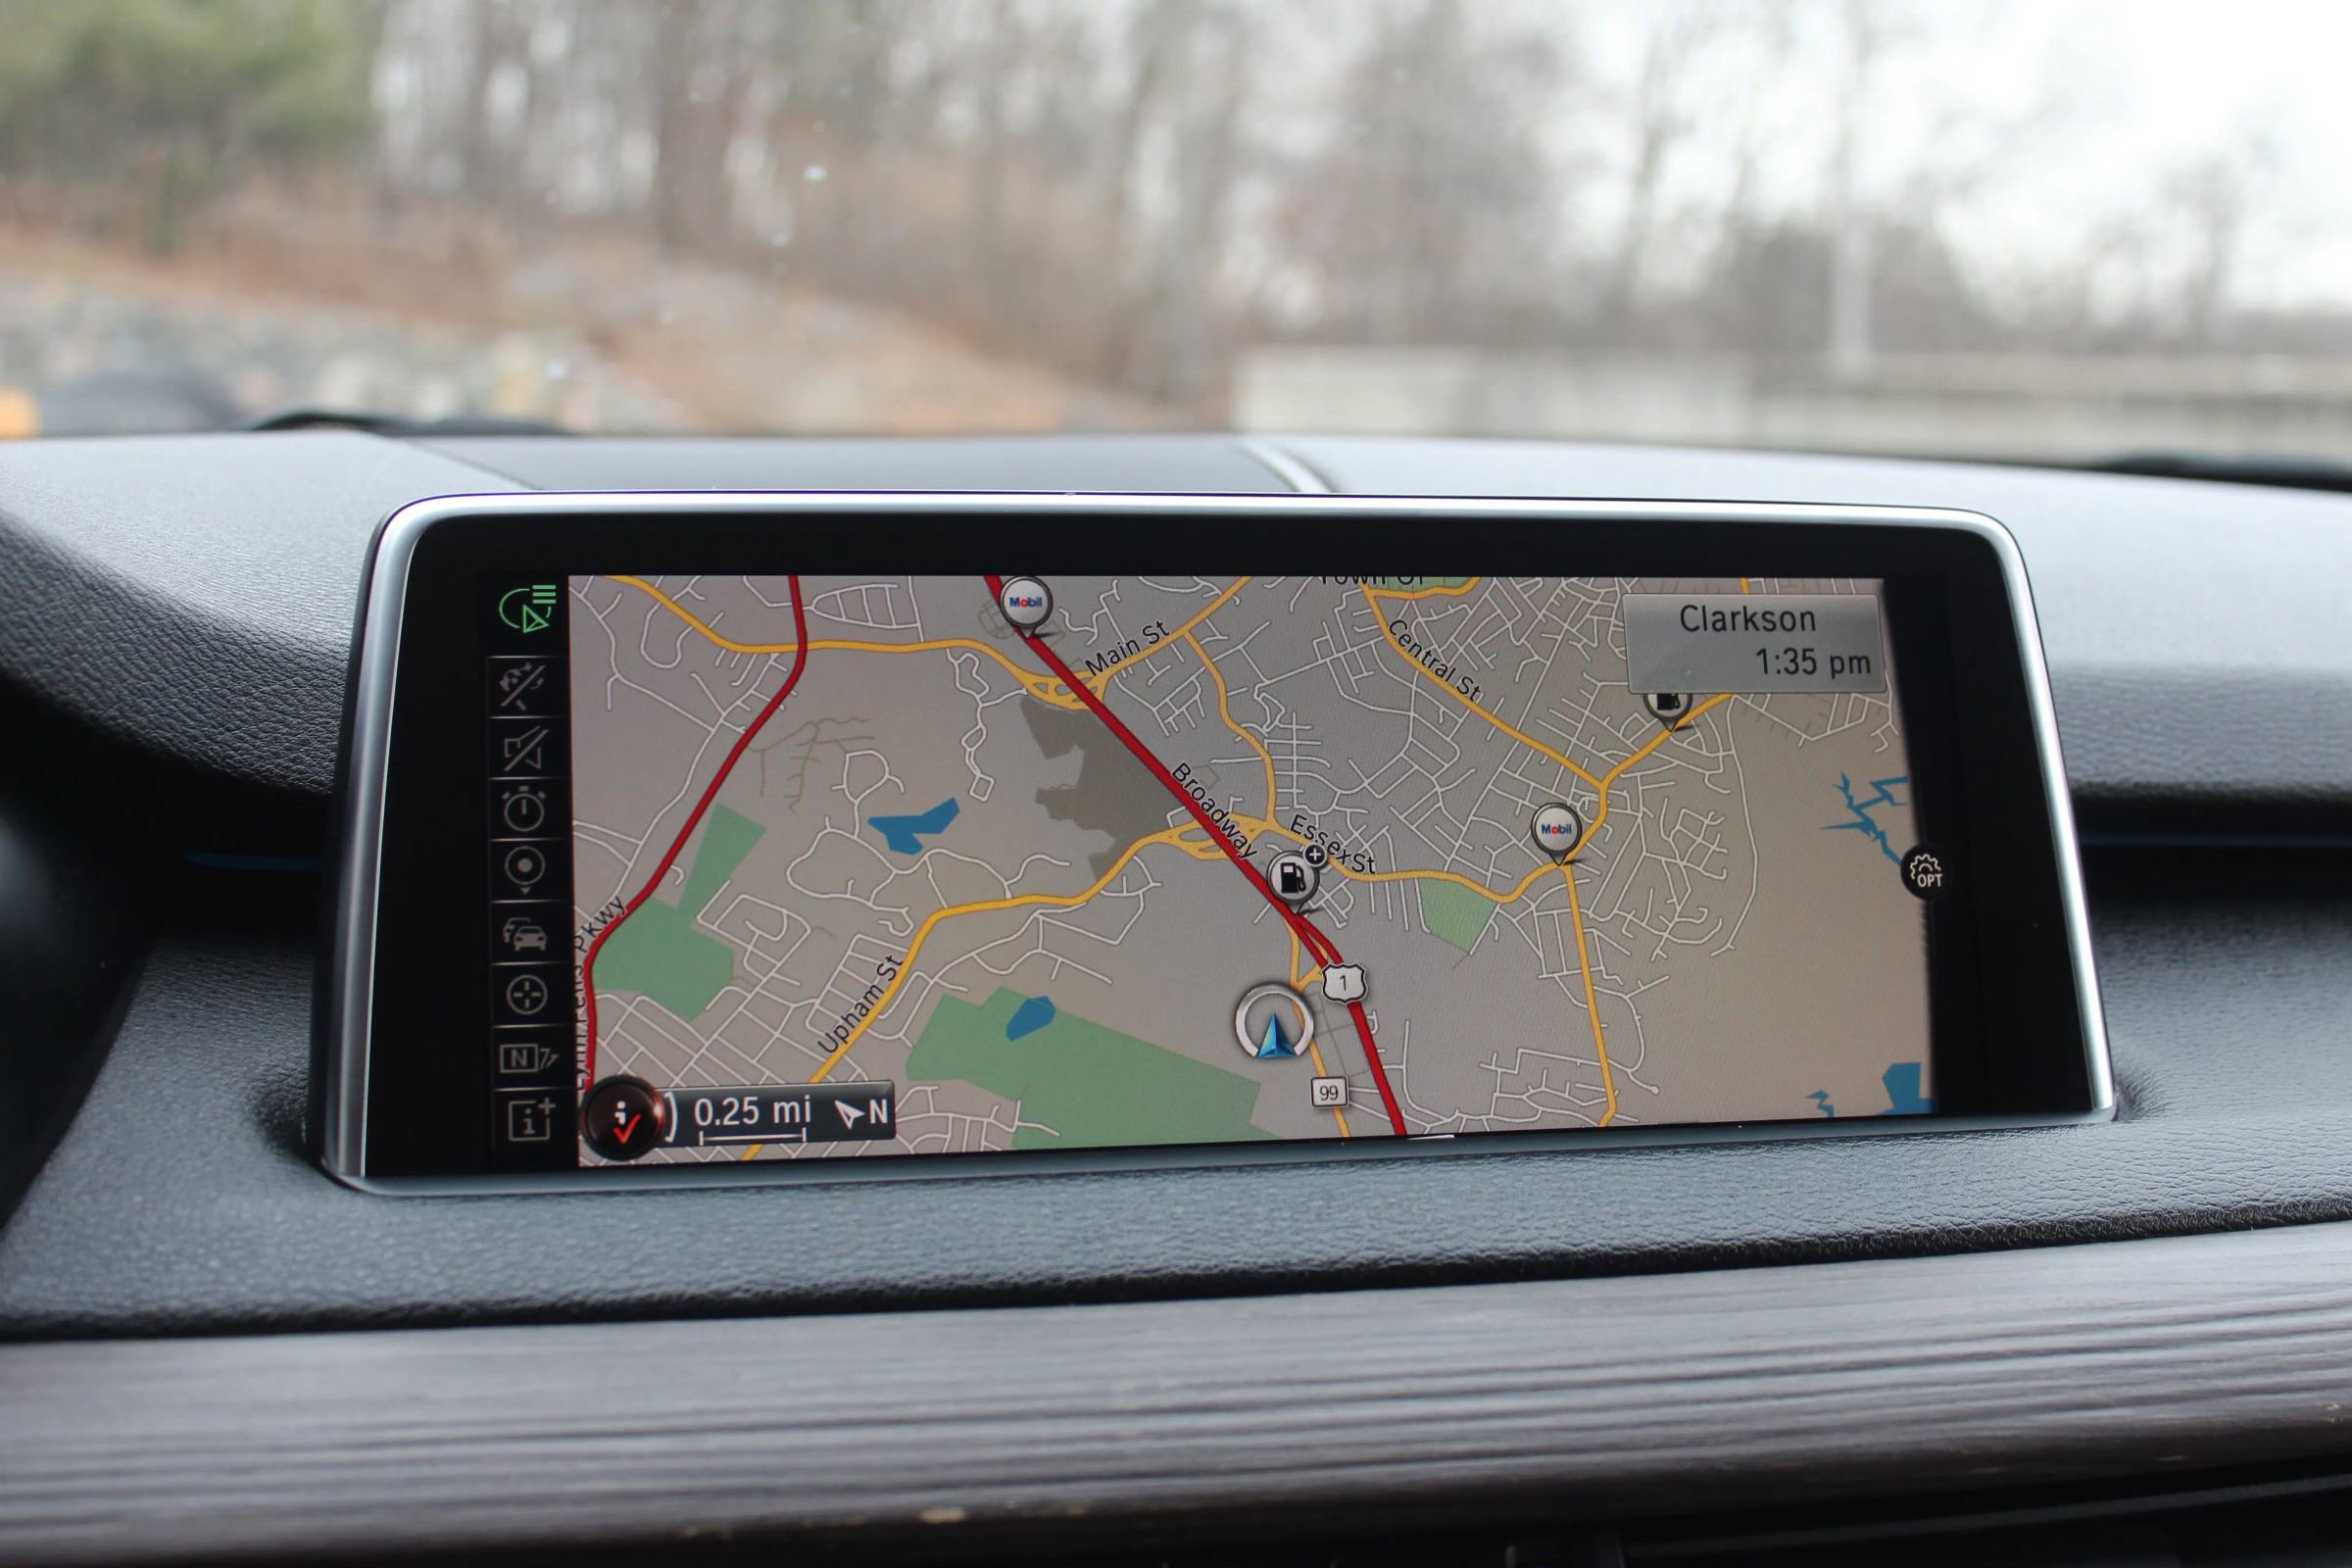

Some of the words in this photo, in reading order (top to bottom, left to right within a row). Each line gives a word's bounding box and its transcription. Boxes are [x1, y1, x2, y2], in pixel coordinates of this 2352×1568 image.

[1008, 596, 1043, 608] Mobil
[1680, 604, 1816, 632] Clarkson
[1084, 636, 1141, 676] Main
[1142, 619, 1170, 645] St
[1389, 619, 1457, 683] Central
[1456, 675, 1482, 703] St
[1755, 647, 1818, 675] 1:35
[1829, 654, 1872, 680] pm
[1171, 761, 1257, 859] Broadway
[1290, 814, 1352, 864] Essex
[1351, 854, 1376, 875] St
[1541, 822, 1572, 836] Mobil
[1917, 872, 1943, 888] OPT
[573, 895, 626, 954] Pkwy
[1339, 974, 1348, 992] 1
[817, 984, 886, 1055] Upham
[876, 954, 905, 983] St
[1319, 1084, 1339, 1102] 99
[694, 1096, 760, 1127] 0.25
[773, 1094, 812, 1124] mi
[869, 1098, 889, 1125] N
